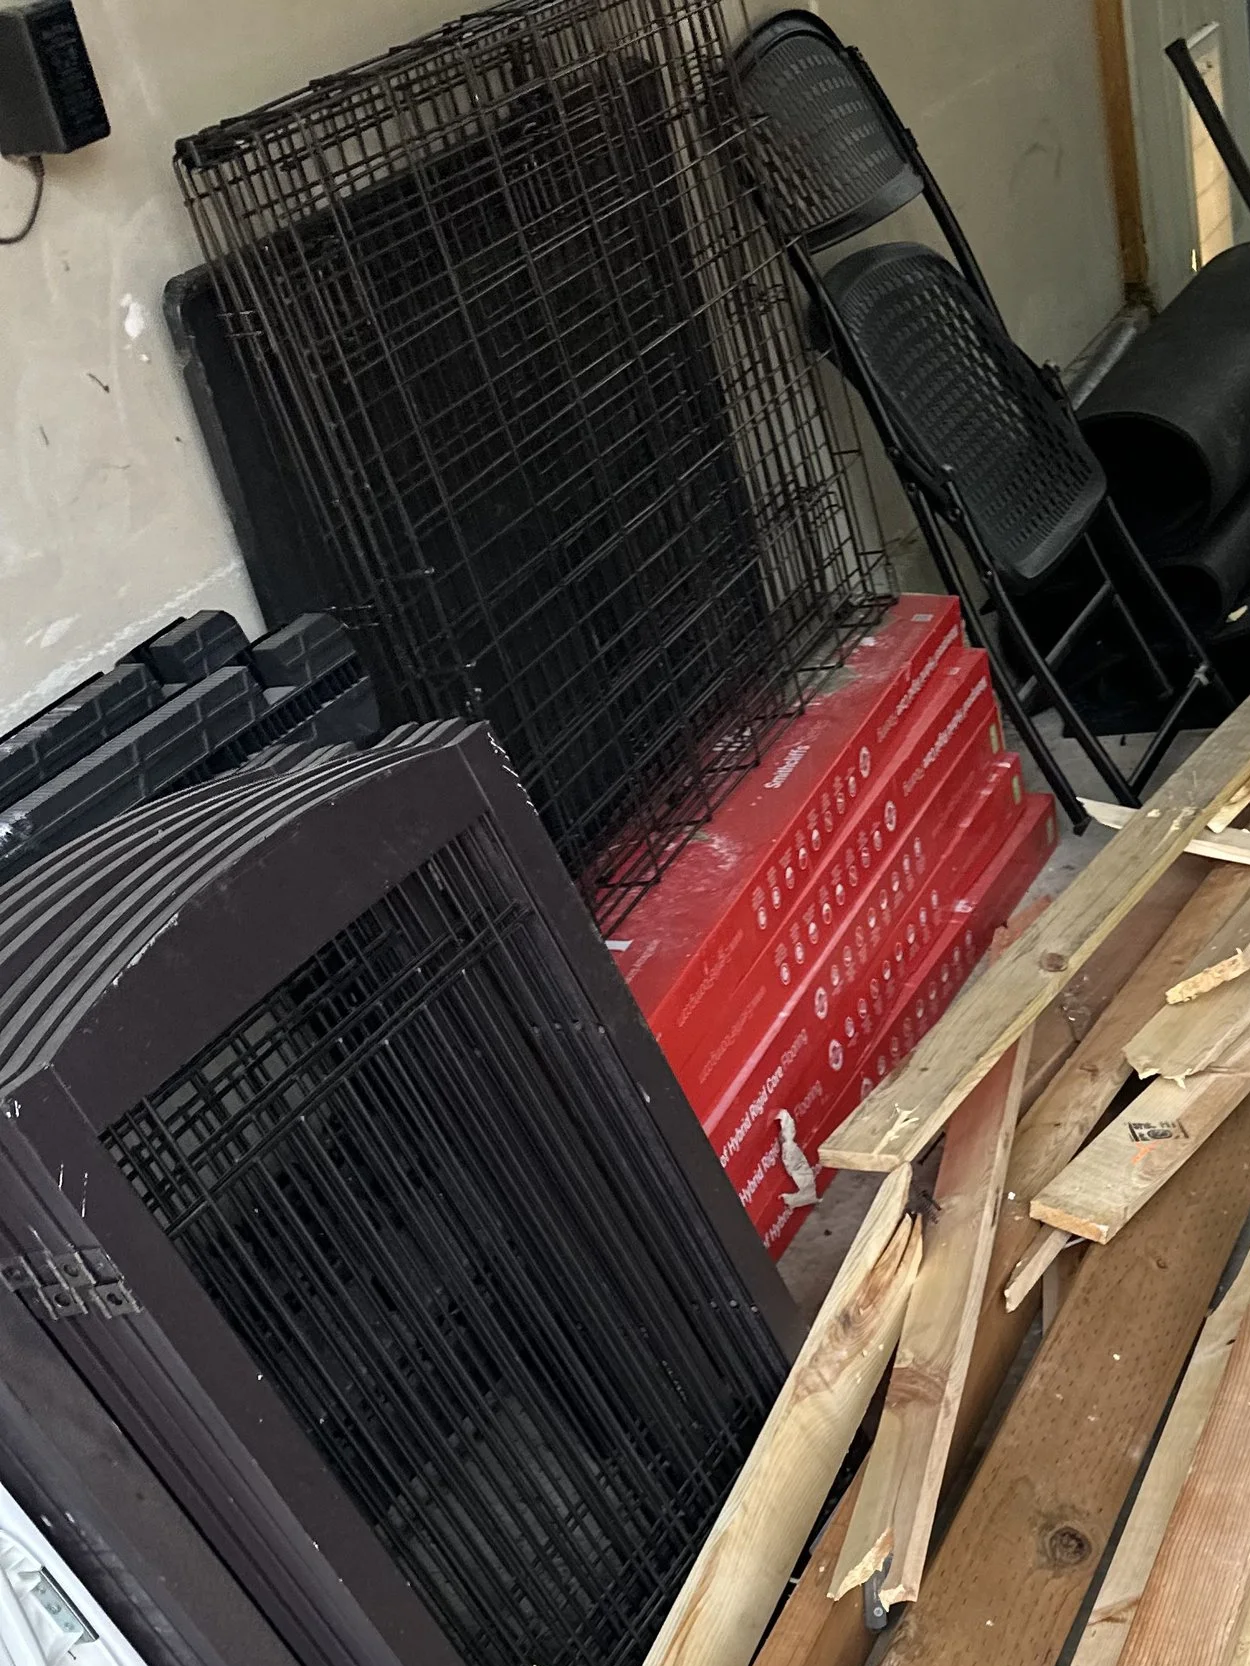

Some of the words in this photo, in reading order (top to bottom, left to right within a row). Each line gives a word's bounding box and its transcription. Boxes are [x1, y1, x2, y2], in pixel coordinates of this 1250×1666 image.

[727, 1111, 752, 1157] Hybrid
[749, 1084, 768, 1120] Rigid
[766, 1065, 784, 1095] Core
